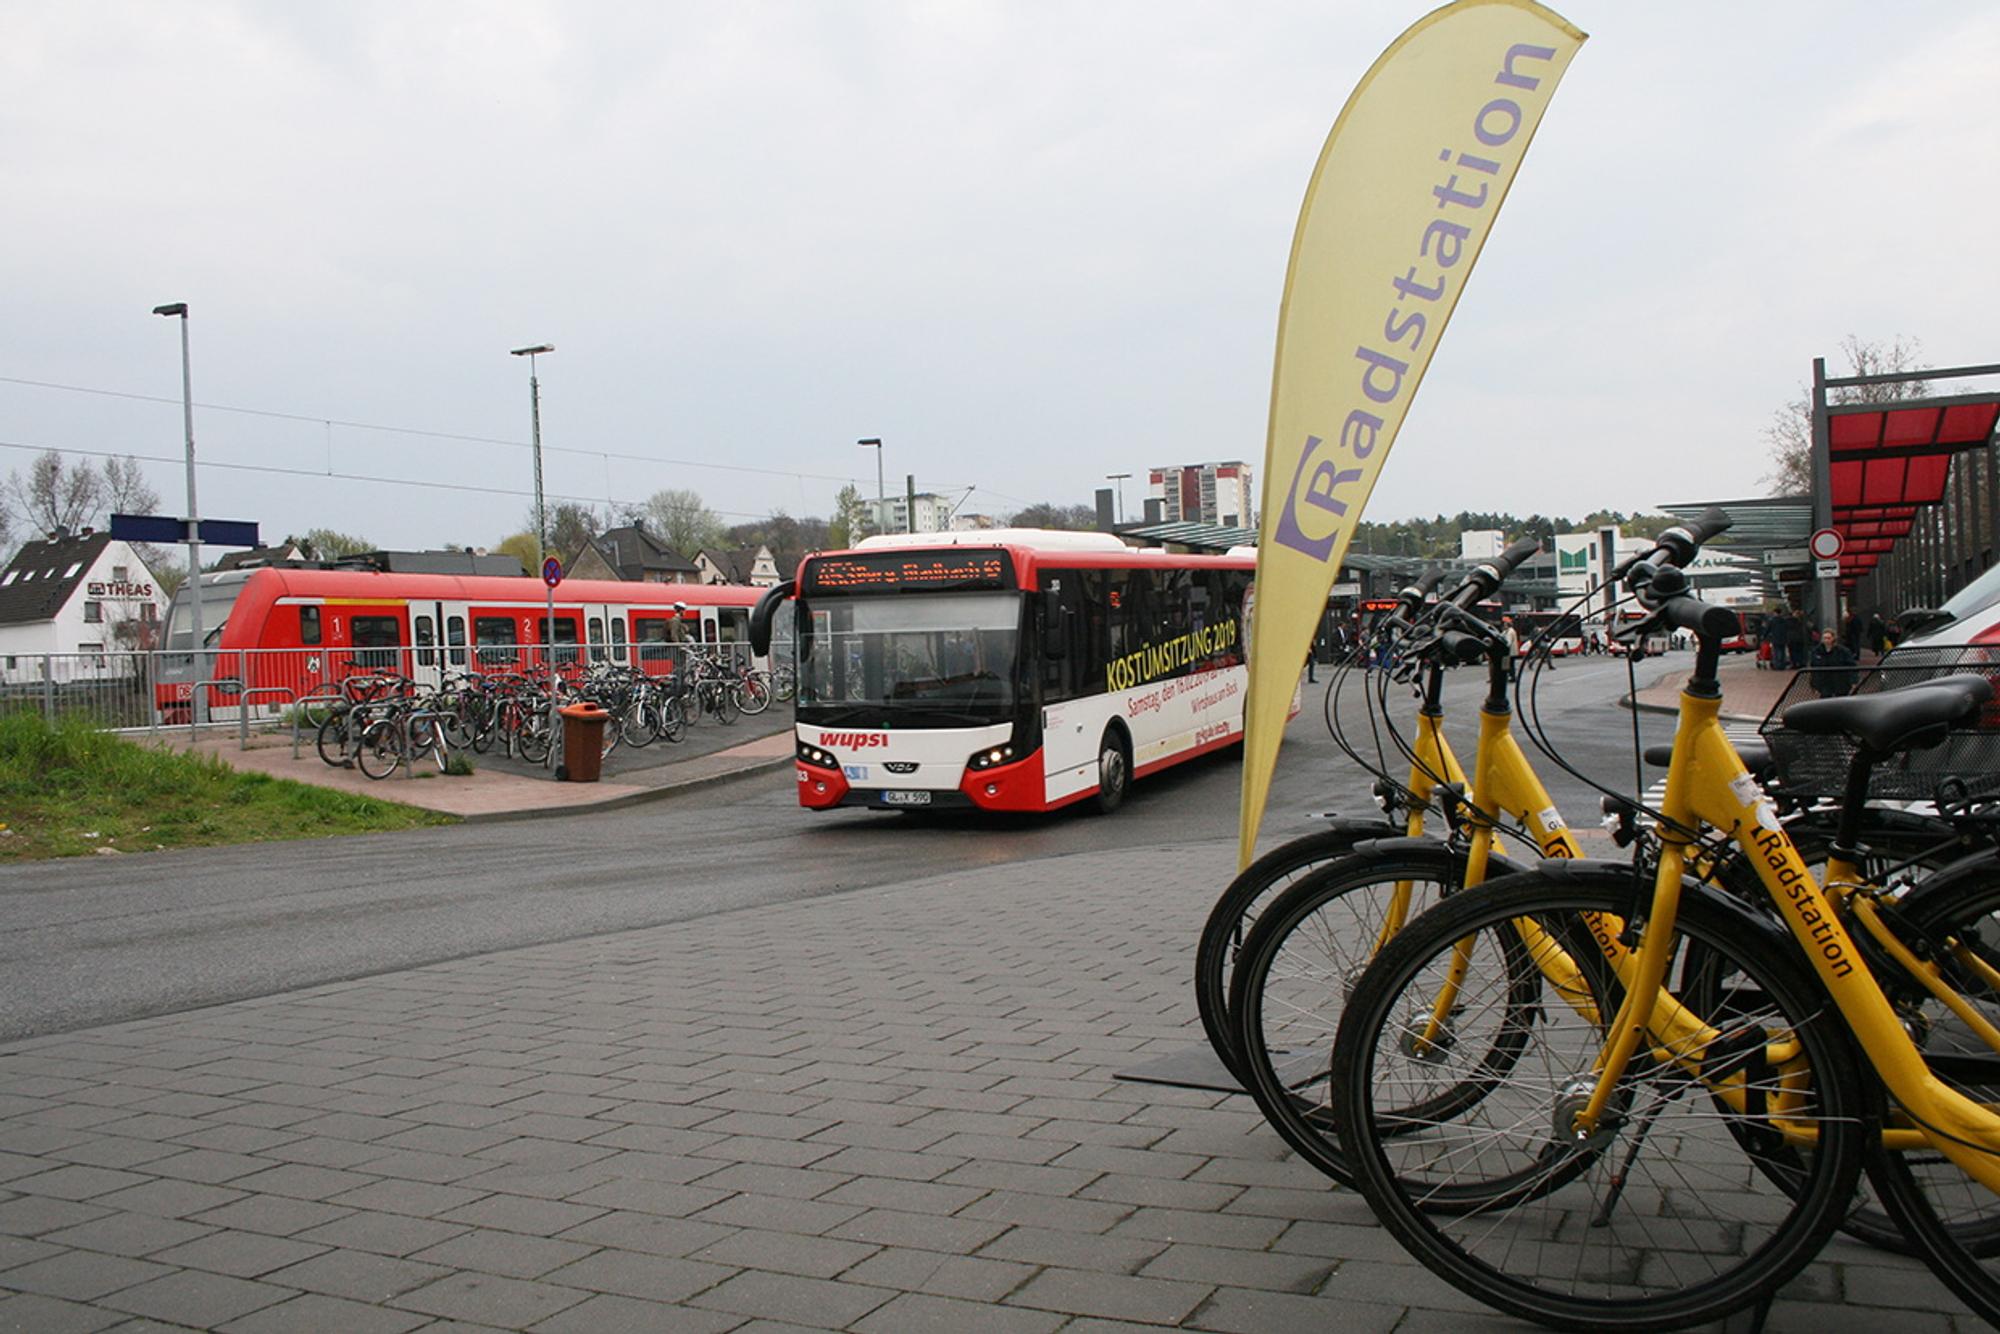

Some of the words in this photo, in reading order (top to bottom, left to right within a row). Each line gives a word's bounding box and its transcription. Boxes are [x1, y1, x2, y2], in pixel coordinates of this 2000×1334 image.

[1305, 42, 1557, 517] Radstation
[106, 583, 152, 596] THEAS
[333, 617, 340, 632] 1
[524, 618, 531, 632] 2
[1106, 626, 1212, 694] KOSTÜMSITZUNG
[1213, 619, 1236, 651] 2019
[820, 733, 888, 751] wupsi
[1757, 833, 1854, 978] Radstation
